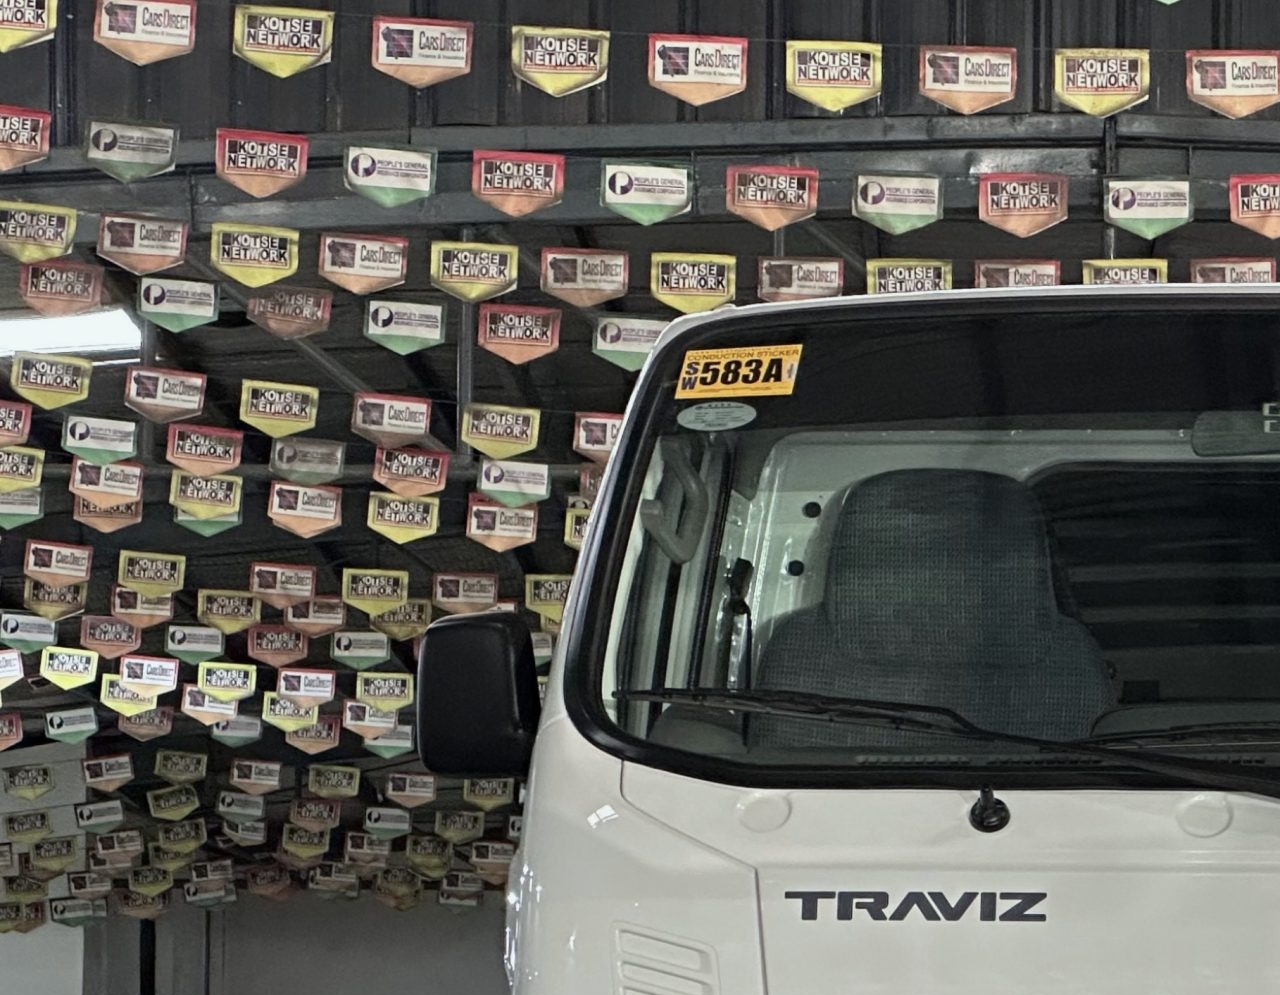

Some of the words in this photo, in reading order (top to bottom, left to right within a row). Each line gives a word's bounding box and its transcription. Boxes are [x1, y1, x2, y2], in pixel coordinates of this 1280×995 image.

[258, 16, 311, 32] KOTSE
[247, 29, 321, 48] NETWORK
[536, 37, 588, 51] KOTSE
[525, 51, 596, 65] NETWORK
[808, 52, 860, 66] KOTSE
[1077, 59, 1128, 72] KOTSE
[798, 66, 870, 80] NETWORK
[1067, 73, 1137, 86] NETWORK
[238, 141, 288, 156] KOTSE
[229, 154, 296, 171] NETWORK
[495, 162, 543, 175] KOTSE
[484, 176, 552, 190] NETWORK
[749, 174, 797, 188] KOTSE
[738, 187, 805, 202] NETWORK
[1000, 183, 1048, 194] KOTSE
[990, 195, 1058, 209] NETWORK
[9, 212, 57, 227] KOTSE
[0, 222, 64, 240] NETWORK
[232, 234, 279, 248] KOTSE
[222, 247, 288, 262] NETWORK
[452, 252, 499, 264] KOTSE
[442, 263, 507, 277] NETWORK
[671, 263, 716, 275] KOTSE
[887, 267, 933, 279] KOTSE
[1103, 268, 1147, 280] KOTSE
[661, 275, 725, 289] NETWORK
[878, 279, 942, 292] NETWORK
[499, 314, 542, 326] KOTSE
[489, 326, 549, 339] NETWORK
[687, 352, 755, 361] CONDUCTION
[757, 349, 799, 358] STICKER
[685, 361, 700, 375] S
[699, 358, 783, 386] 583A
[681, 376, 698, 390] W
[259, 389, 300, 402] KOTSE
[251, 401, 307, 415] NETWORK
[481, 412, 523, 424] KOTSE
[472, 423, 528, 437] NETWORK
[393, 452, 433, 466] KOTSE
[785, 891, 1047, 921] TRAVIZ
